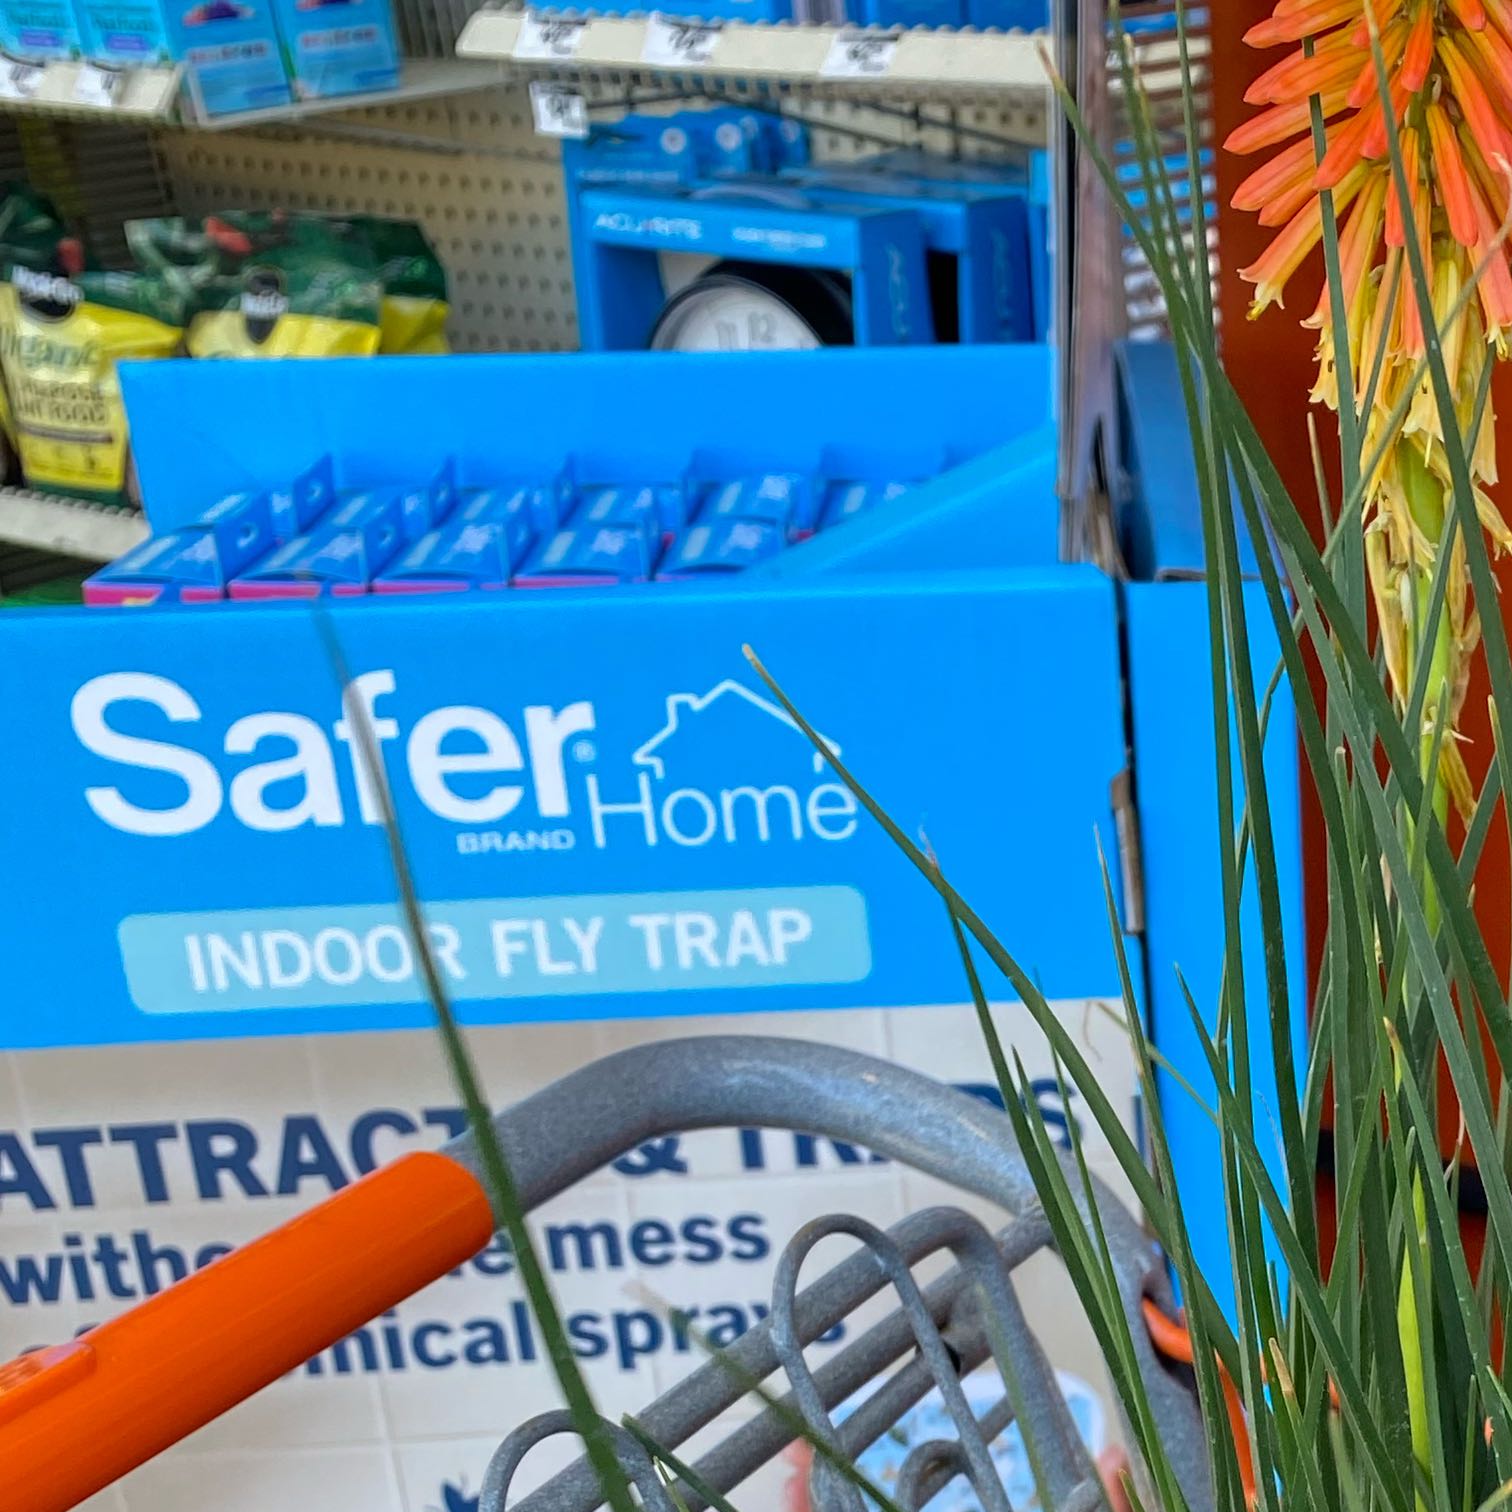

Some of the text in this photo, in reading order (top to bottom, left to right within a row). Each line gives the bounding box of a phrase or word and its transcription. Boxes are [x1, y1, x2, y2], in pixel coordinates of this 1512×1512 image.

[71, 669, 858, 848] Safer Home
[457, 829, 575, 854] BRAND
[185, 907, 813, 992] INDOOR FLY TRAP
[0, 1231, 235, 1305] with
[546, 1212, 770, 1271] mess
[305, 1300, 537, 1376] mical
